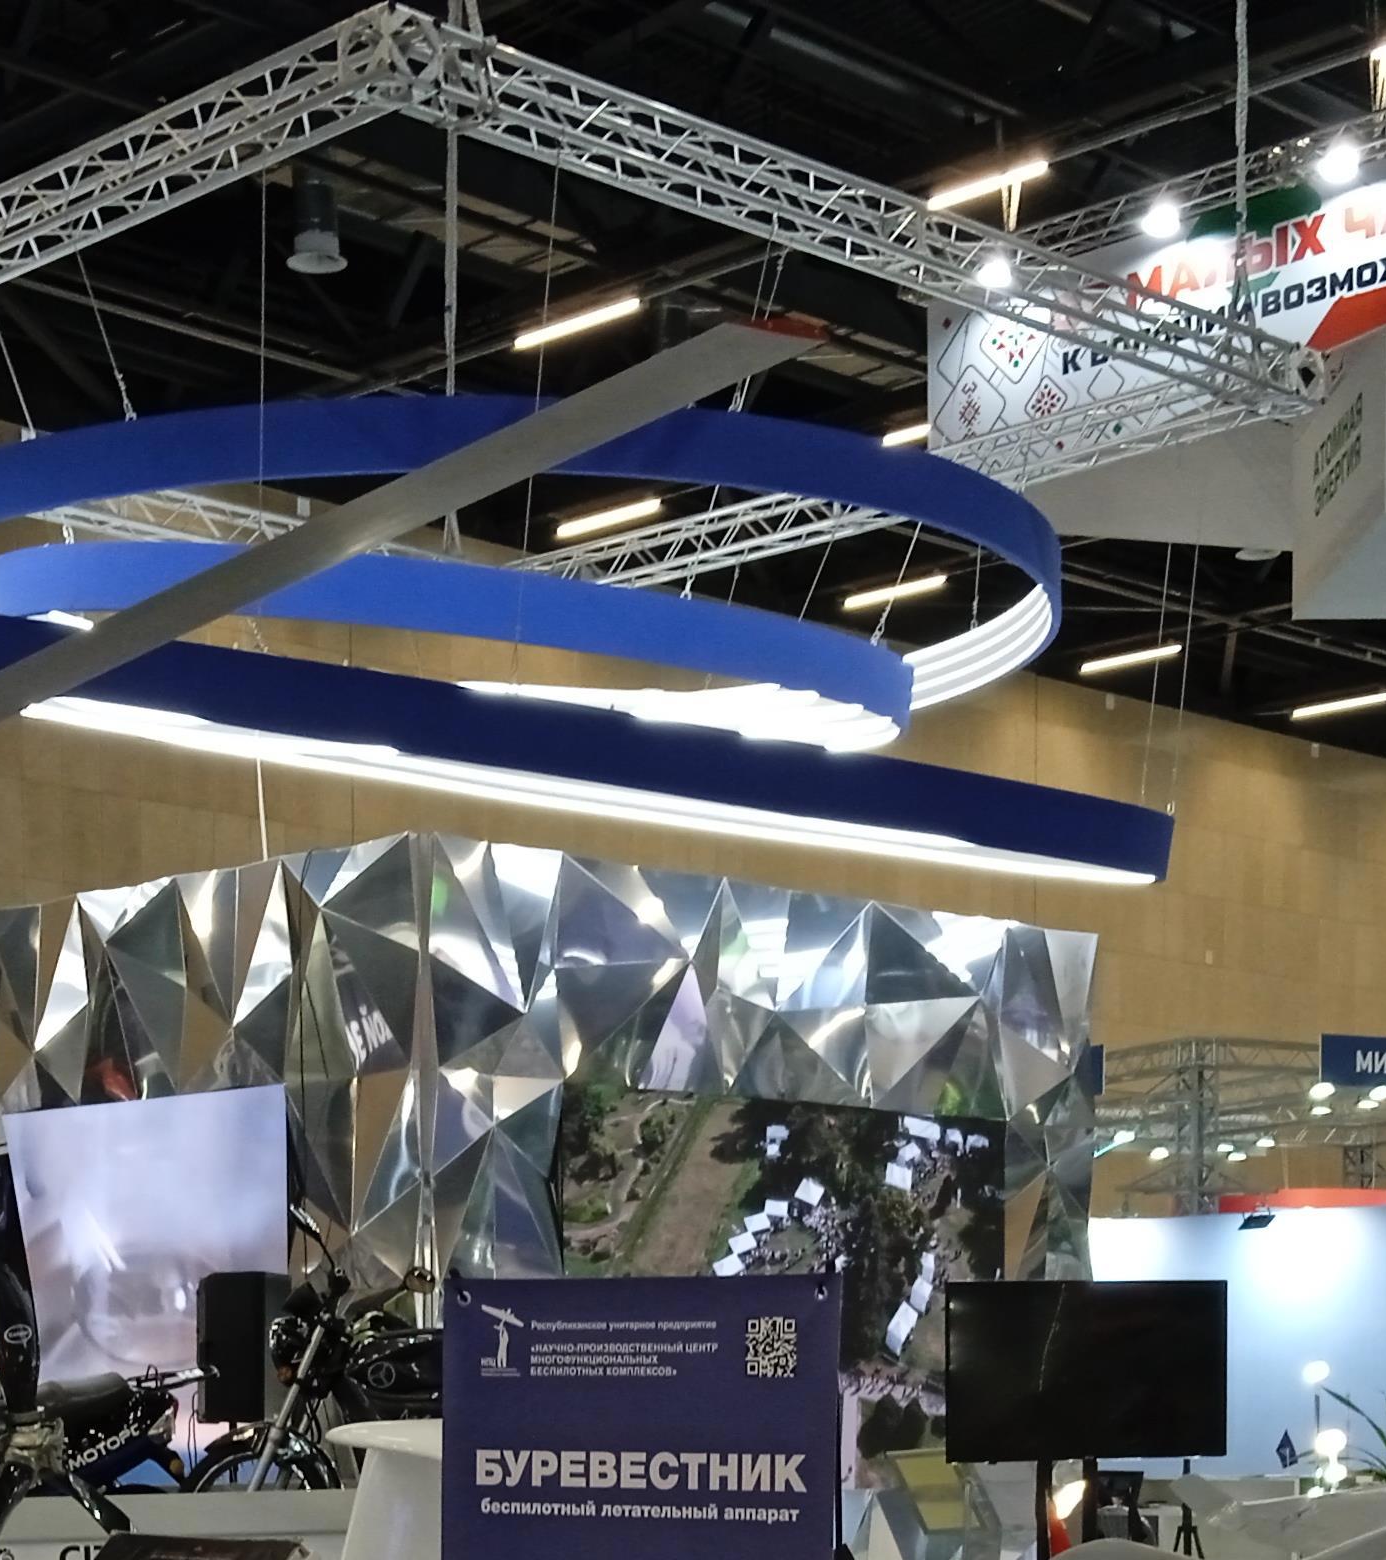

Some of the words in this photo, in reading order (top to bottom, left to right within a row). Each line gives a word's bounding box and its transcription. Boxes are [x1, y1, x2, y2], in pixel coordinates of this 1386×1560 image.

[1062, 350, 1086, 375] К
[530, 1320, 607, 1333] Республиканское
[608, 1321, 656, 1331] унитарное
[657, 1321, 717, 1332] предприятие
[530, 1341, 682, 1353] «НАУЧНО-ПРОИЗВОДСТВЕННЫЙ
[685, 1343, 719, 1355] ЦЕНТР
[480, 1357, 498, 1367] НПЦ
[530, 1355, 659, 1365] МНОГОФУНКЦИОНАЛЬНЫХ
[530, 1367, 604, 1377] БЕСПИЛОТНЫХ
[606, 1367, 678, 1377] КОМПЛЕКСОВ»
[475, 1448, 808, 1493] БУРЕВЕСТНИК
[480, 1497, 597, 1517] беспилотный
[600, 1501, 719, 1520] летательный
[723, 1507, 800, 1525] аппарат
